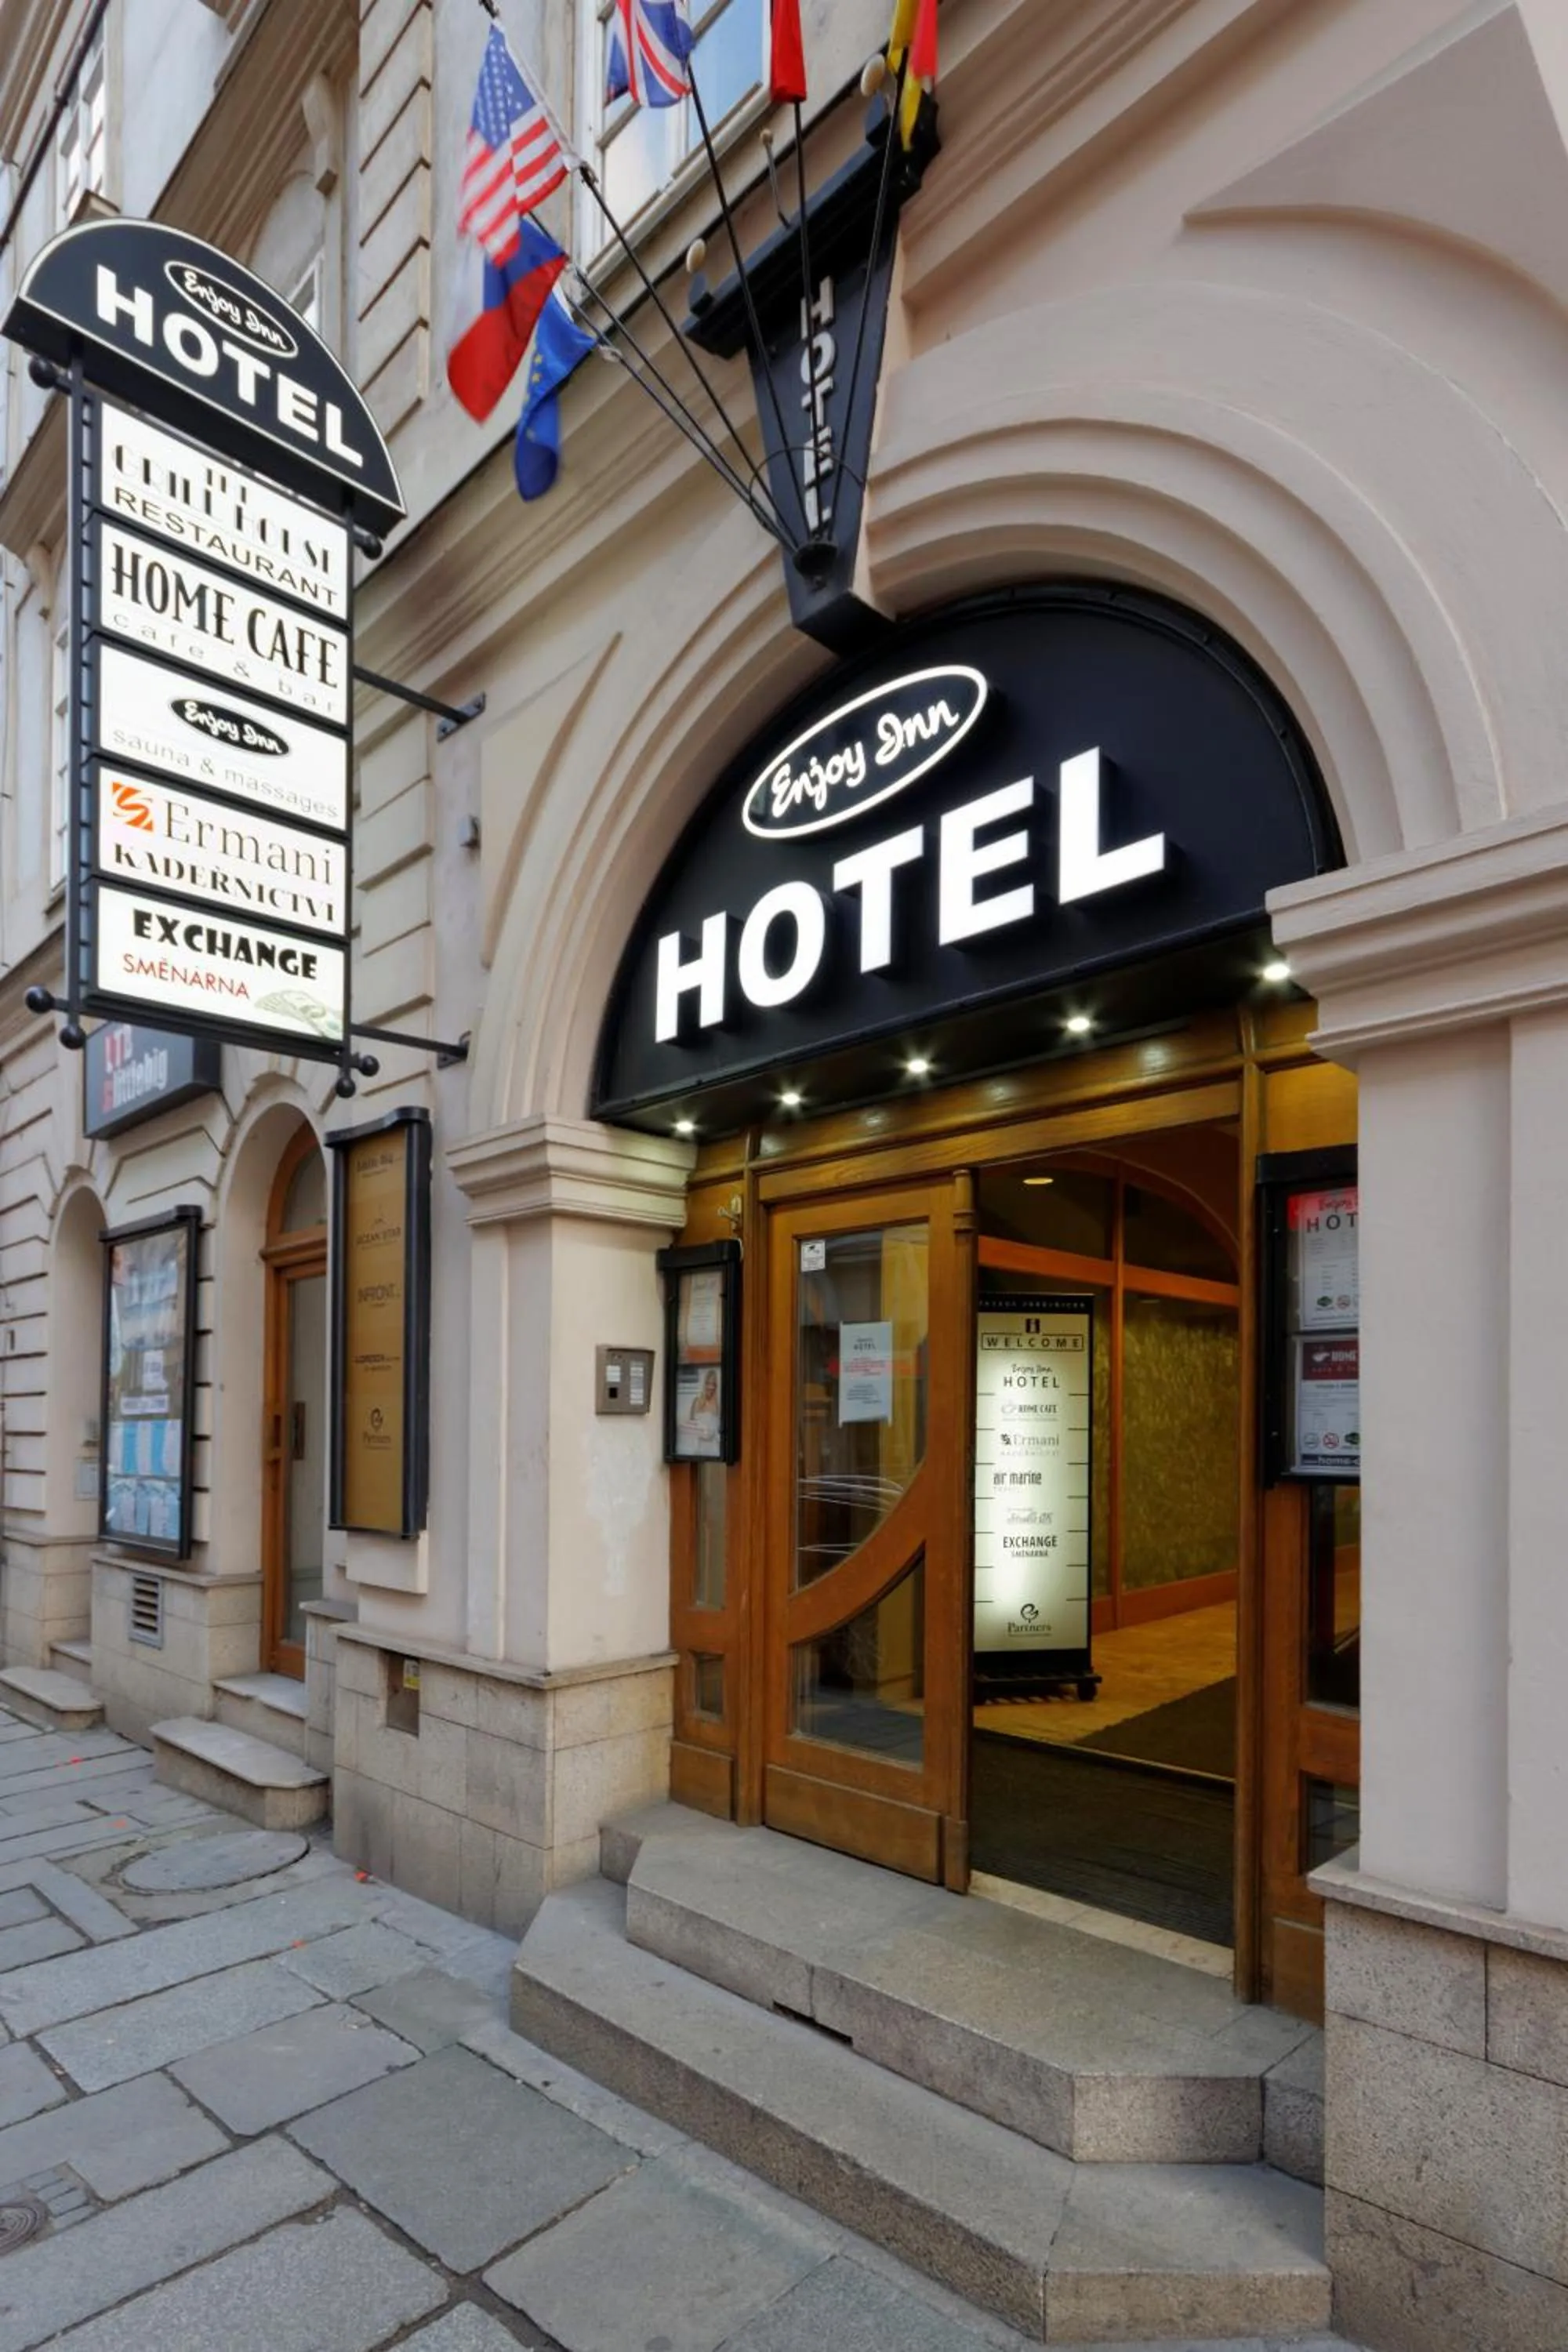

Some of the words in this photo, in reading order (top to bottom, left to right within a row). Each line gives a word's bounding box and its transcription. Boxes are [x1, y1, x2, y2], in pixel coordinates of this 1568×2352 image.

[184, 270, 241, 325] Enjoy
[245, 308, 287, 350] Inn
[96, 263, 363, 468] HOTEL
[800, 275, 834, 535] HOTEL
[114, 486, 338, 606] RESTAURANT
[111, 543, 235, 646] HOME
[248, 608, 338, 690] CAFE
[183, 701, 240, 740] Enjoy
[243, 724, 283, 754] Inn
[233, 660, 251, 678] &
[278, 679, 338, 713] bar
[113, 729, 190, 768] sauna
[200, 757, 216, 775] &
[224, 769, 338, 819] massages
[770, 741, 866, 817] Enjoy
[875, 699, 960, 766] Inn
[164, 799, 332, 885] Ermani
[655, 746, 1166, 1044] HOTEL
[133, 909, 318, 980] EXCHANGE
[986, 1338, 1080, 1348] WELCOME
[1004, 1376, 1060, 1388] HOTEL
[1003, 1535, 1058, 1548] EXCHANGE
